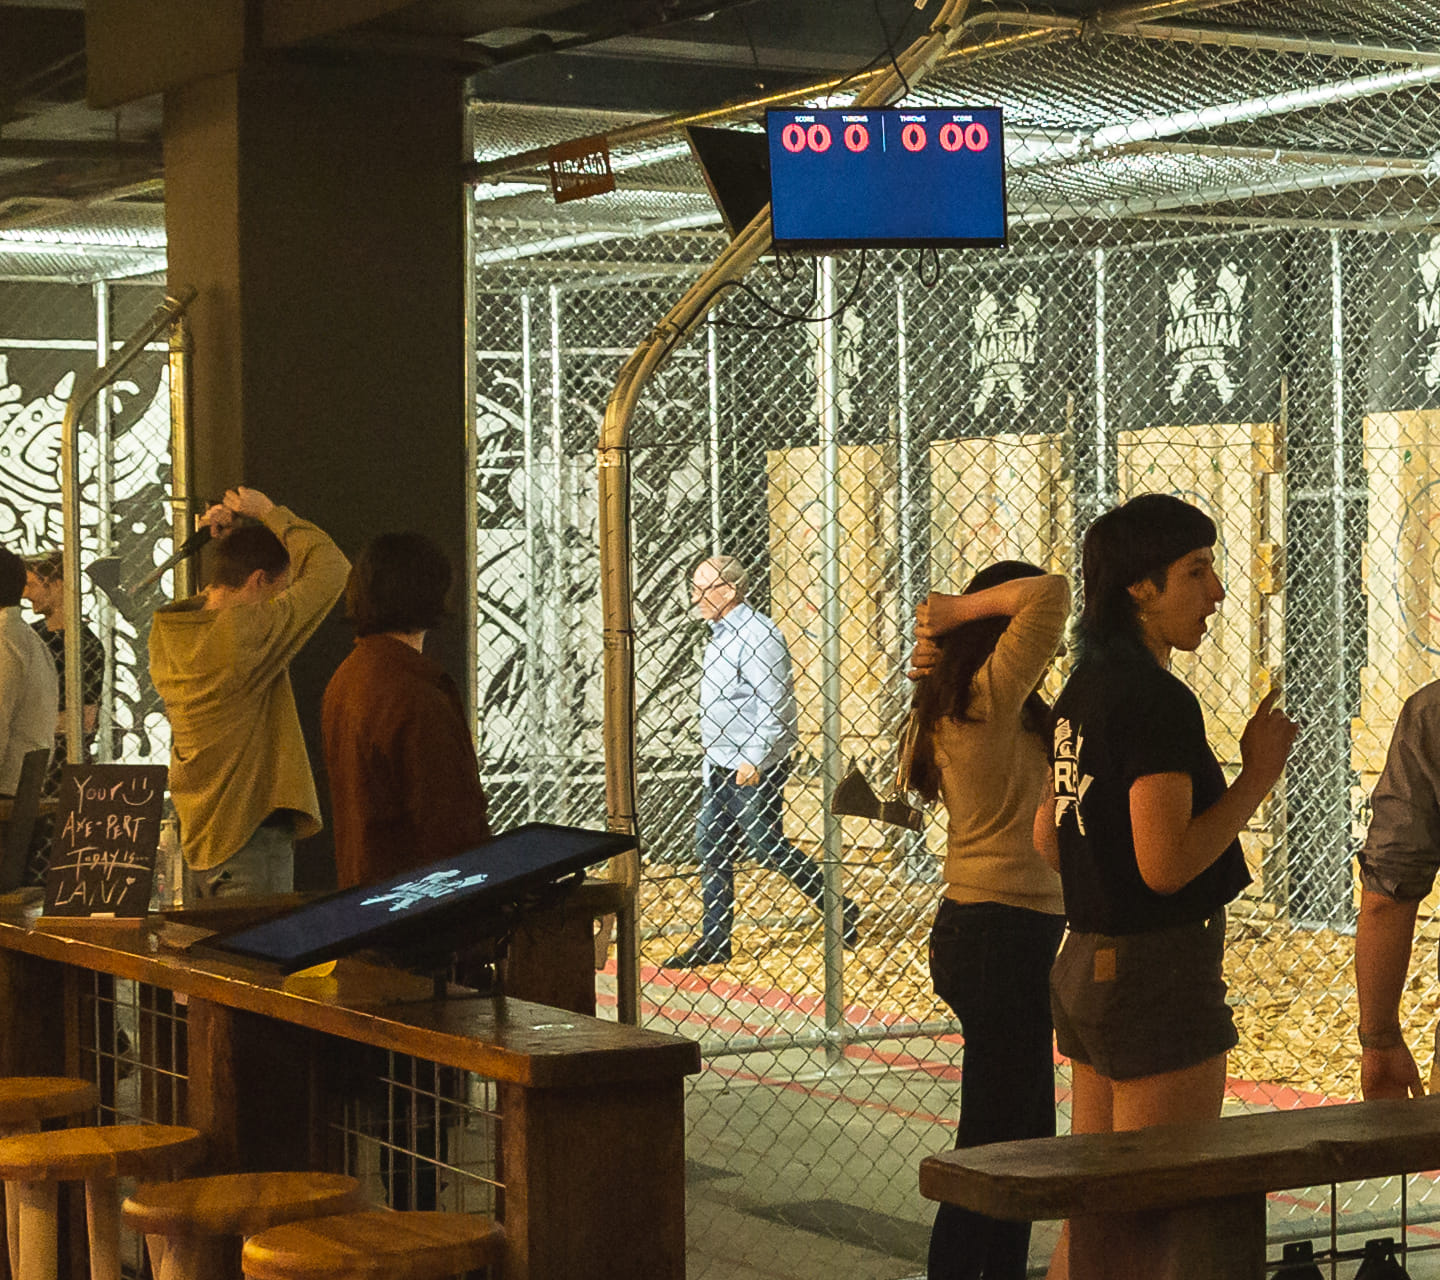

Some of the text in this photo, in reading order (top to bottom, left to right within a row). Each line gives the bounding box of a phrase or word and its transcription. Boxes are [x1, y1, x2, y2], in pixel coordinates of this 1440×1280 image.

[782, 122, 989, 153] 00 0 0 00
